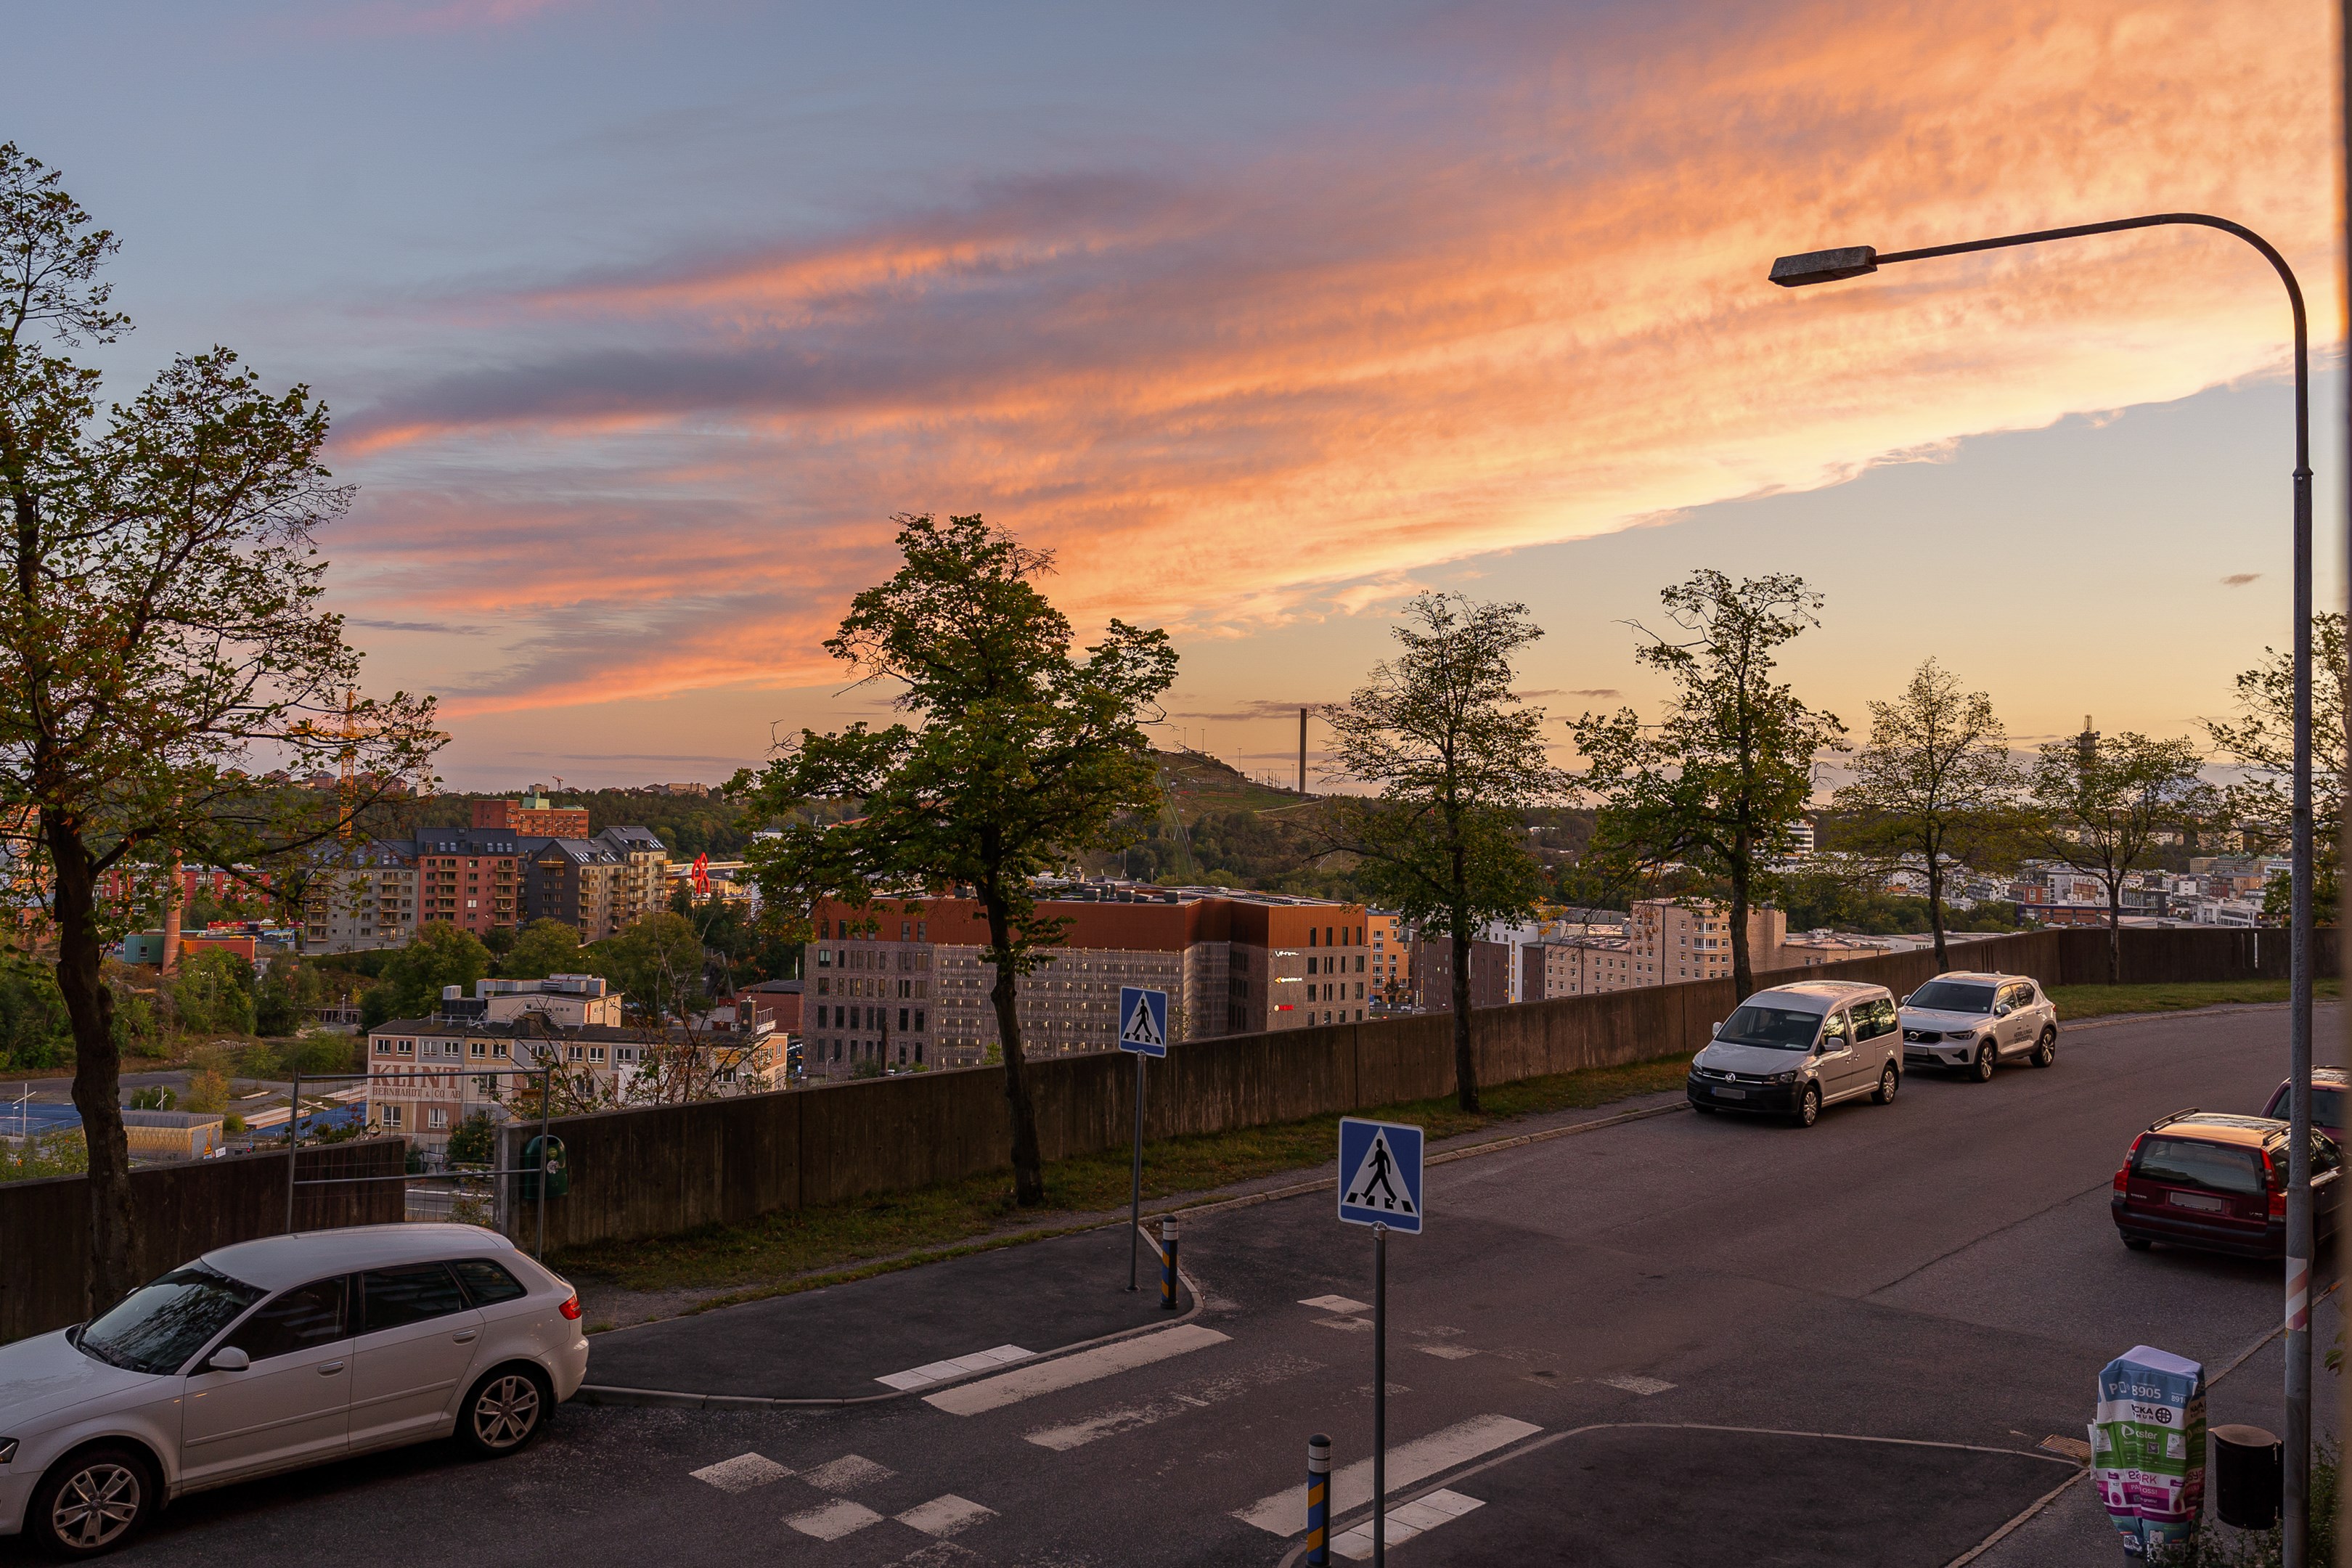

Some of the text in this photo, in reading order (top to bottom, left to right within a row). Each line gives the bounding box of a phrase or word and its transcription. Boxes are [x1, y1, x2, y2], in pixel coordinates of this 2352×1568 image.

[372, 1064, 461, 1089] KLINT
[372, 1087, 422, 1097] BERNHARDT
[2132, 1385, 2161, 1399] 8905
[2131, 1404, 2153, 1416] CKA
